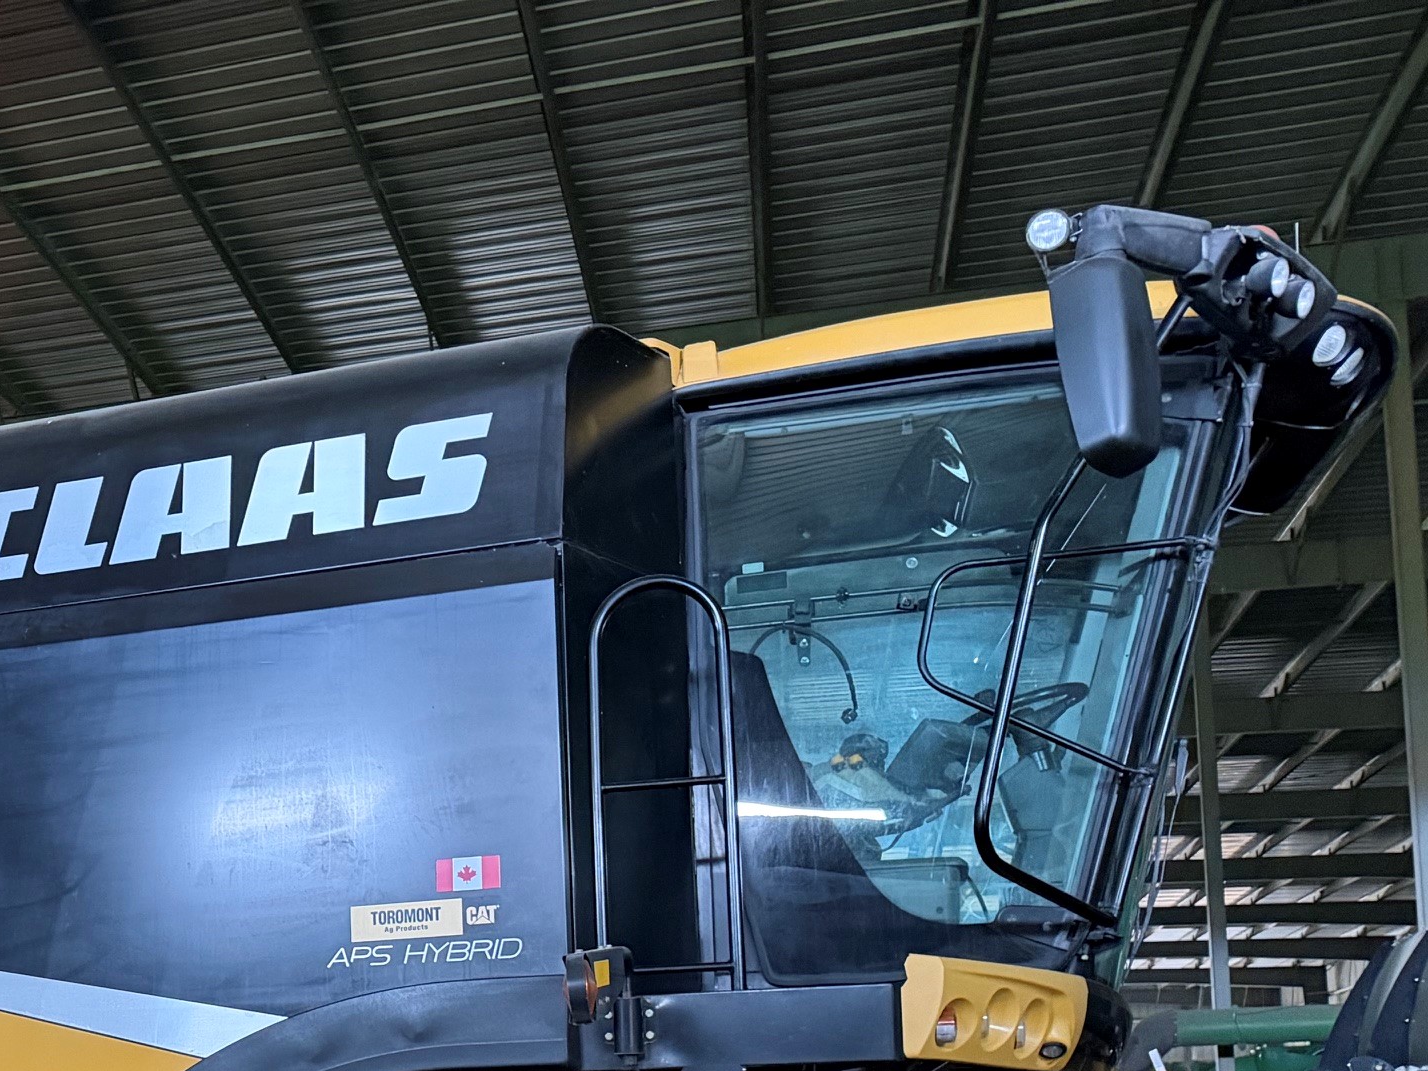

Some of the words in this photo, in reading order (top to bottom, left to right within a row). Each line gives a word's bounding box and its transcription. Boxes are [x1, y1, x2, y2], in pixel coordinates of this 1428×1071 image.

[371, 906, 441, 926] TOROMONT
[466, 905, 495, 926] CAT
[384, 926, 394, 934] Ag
[396, 923, 428, 932] Products
[327, 944, 394, 969] APS
[403, 937, 523, 965] HYBRID
